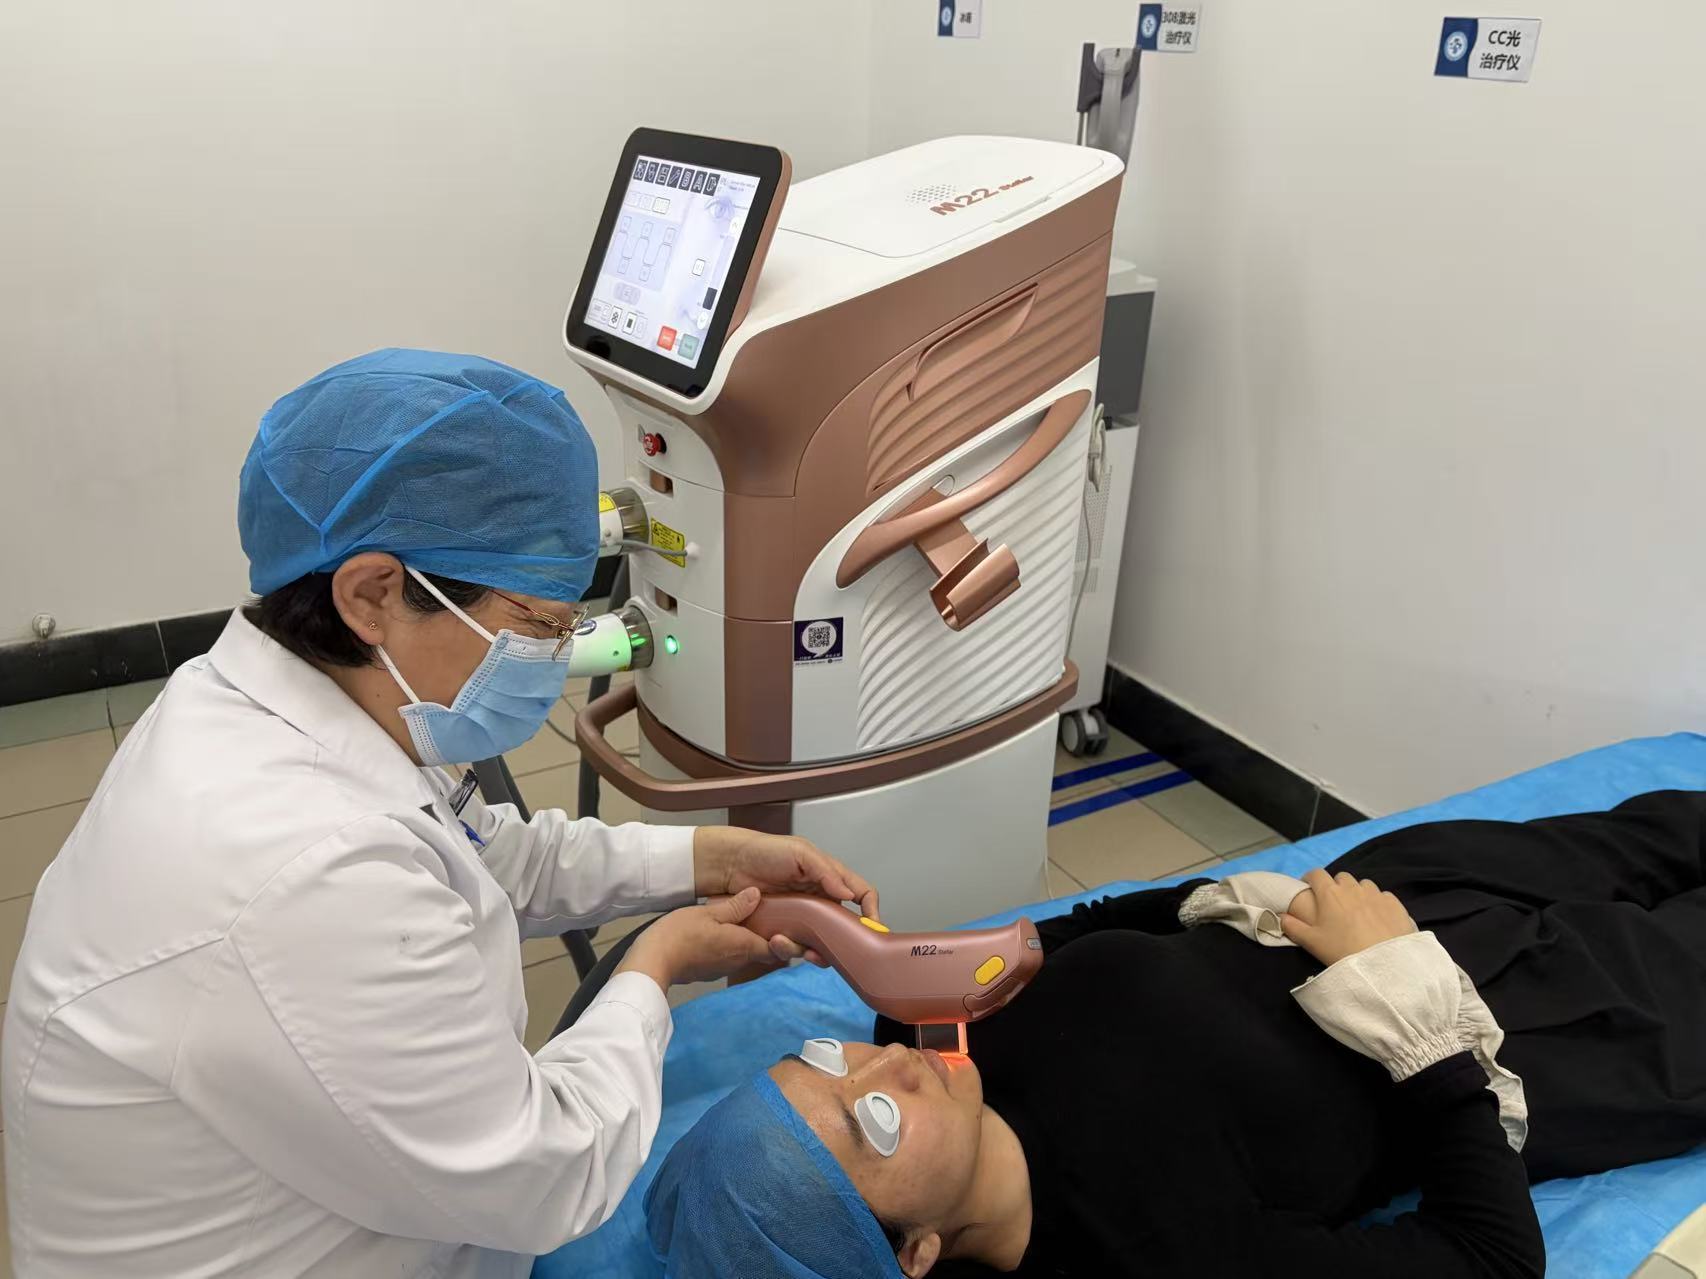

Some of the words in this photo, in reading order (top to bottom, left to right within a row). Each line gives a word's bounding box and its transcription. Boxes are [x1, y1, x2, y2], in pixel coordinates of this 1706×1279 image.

[1165, 30, 1192, 45] 治疗仪
[1488, 30, 1521, 47] CC光
[1479, 53, 1521, 71] 治疗仪
[929, 188, 1000, 216] M22
[911, 944, 937, 957] M22
